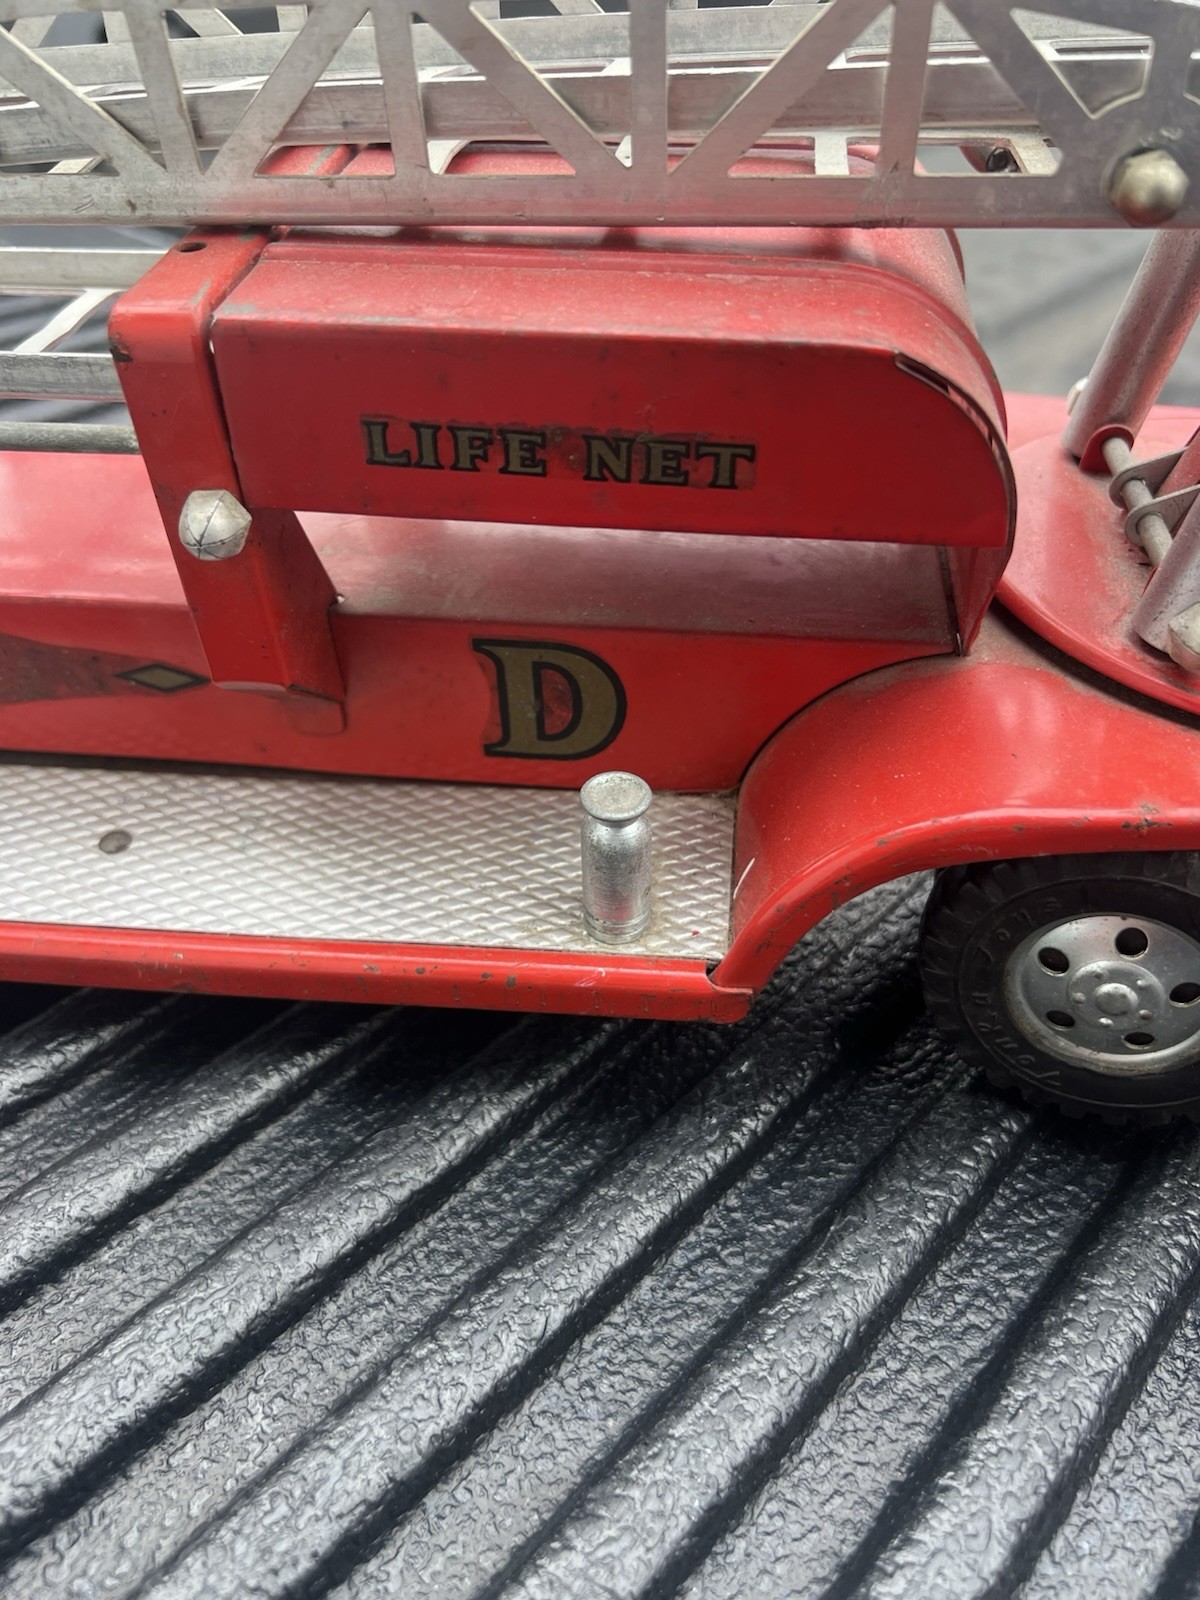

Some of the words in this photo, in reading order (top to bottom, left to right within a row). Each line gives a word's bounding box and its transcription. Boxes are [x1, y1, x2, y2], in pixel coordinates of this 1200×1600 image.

[361, 418, 547, 478] LIFE
[582, 433, 757, 490] NET
[472, 637, 628, 761] D
